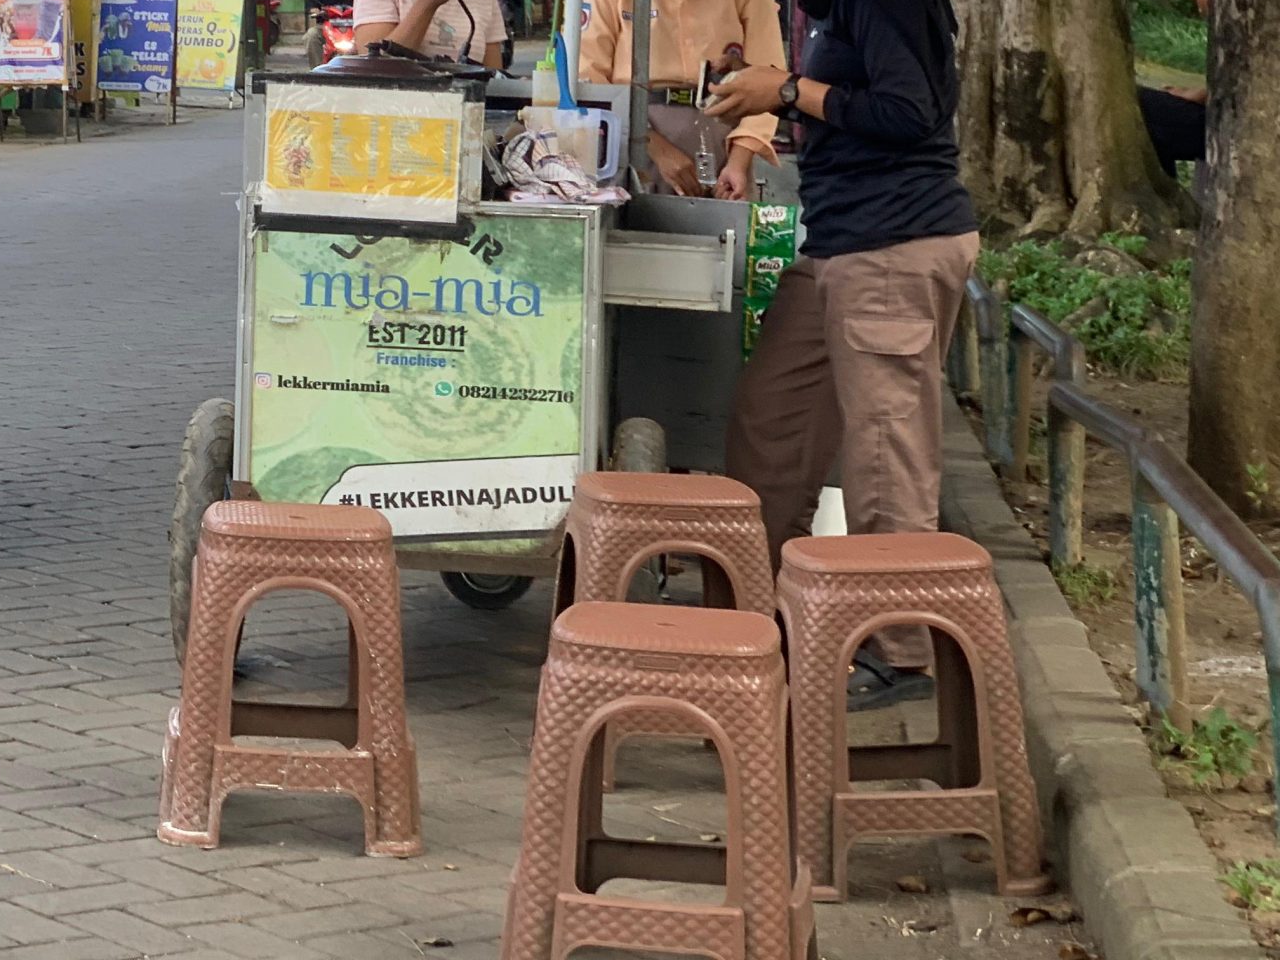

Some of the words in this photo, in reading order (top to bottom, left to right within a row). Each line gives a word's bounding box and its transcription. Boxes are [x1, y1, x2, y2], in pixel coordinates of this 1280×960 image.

[133, 11, 169, 21] STICKY
[177, 26, 203, 35] PERAS
[144, 41, 158, 50] ES
[177, 36, 224, 48] JUMBO
[131, 51, 170, 62] TELLER
[756, 262, 781, 270] MILO
[299, 261, 545, 317] mia-mia
[368, 324, 410, 344] EST
[417, 323, 467, 347] 2011
[375, 352, 447, 368] Franchise
[276, 374, 391, 394] lekkermiamia
[458, 384, 575, 404] 082142322716
[338, 485, 577, 509] #LEKKERINAJADUL
